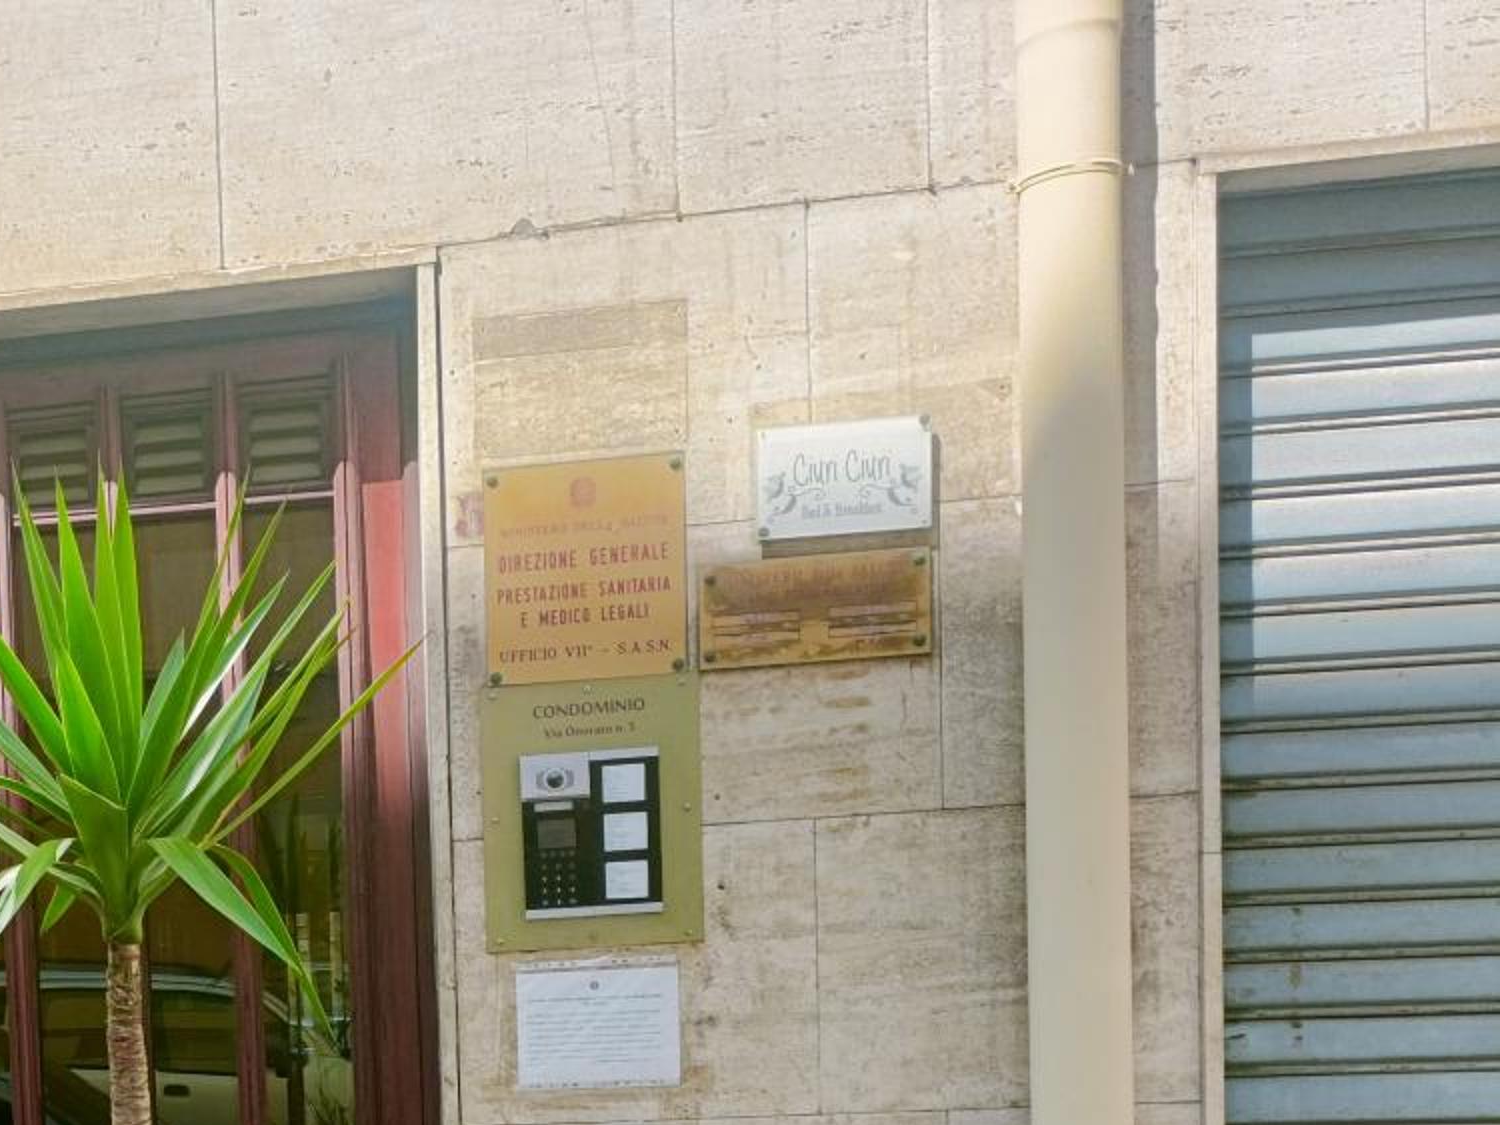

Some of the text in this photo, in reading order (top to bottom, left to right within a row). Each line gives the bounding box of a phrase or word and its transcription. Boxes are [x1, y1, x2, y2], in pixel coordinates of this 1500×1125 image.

[498, 541, 670, 574] DIREZIONE GENERALE
[497, 575, 671, 606] PRESTAZIONE SANITARIA
[519, 603, 649, 629] E MEDICO LEGALI
[499, 645, 557, 664] UFFICIO
[533, 696, 645, 719] CONDOMINIO
[543, 727, 563, 740] Via
